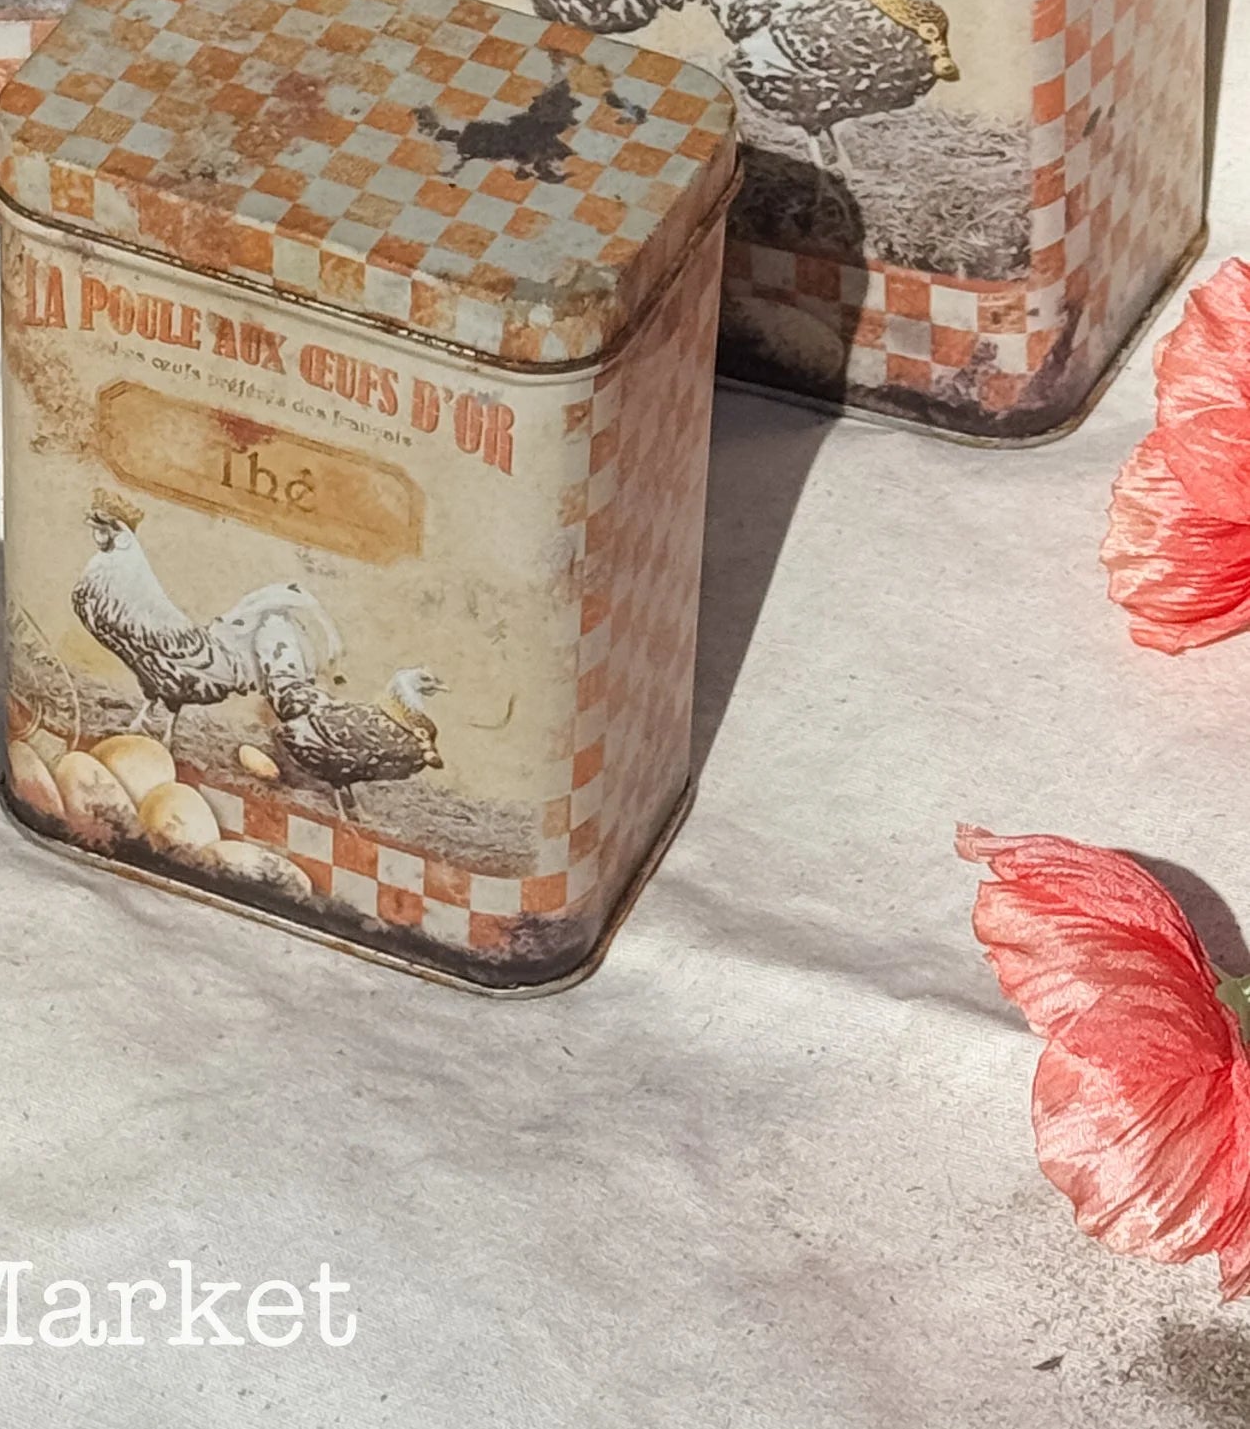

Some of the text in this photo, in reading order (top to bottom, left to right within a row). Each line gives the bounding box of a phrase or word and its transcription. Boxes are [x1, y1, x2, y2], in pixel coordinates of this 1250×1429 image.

[24, 255, 66, 329] LA
[79, 273, 202, 350] POULE
[209, 313, 287, 375] AUX
[409, 378, 515, 476] D'OR
